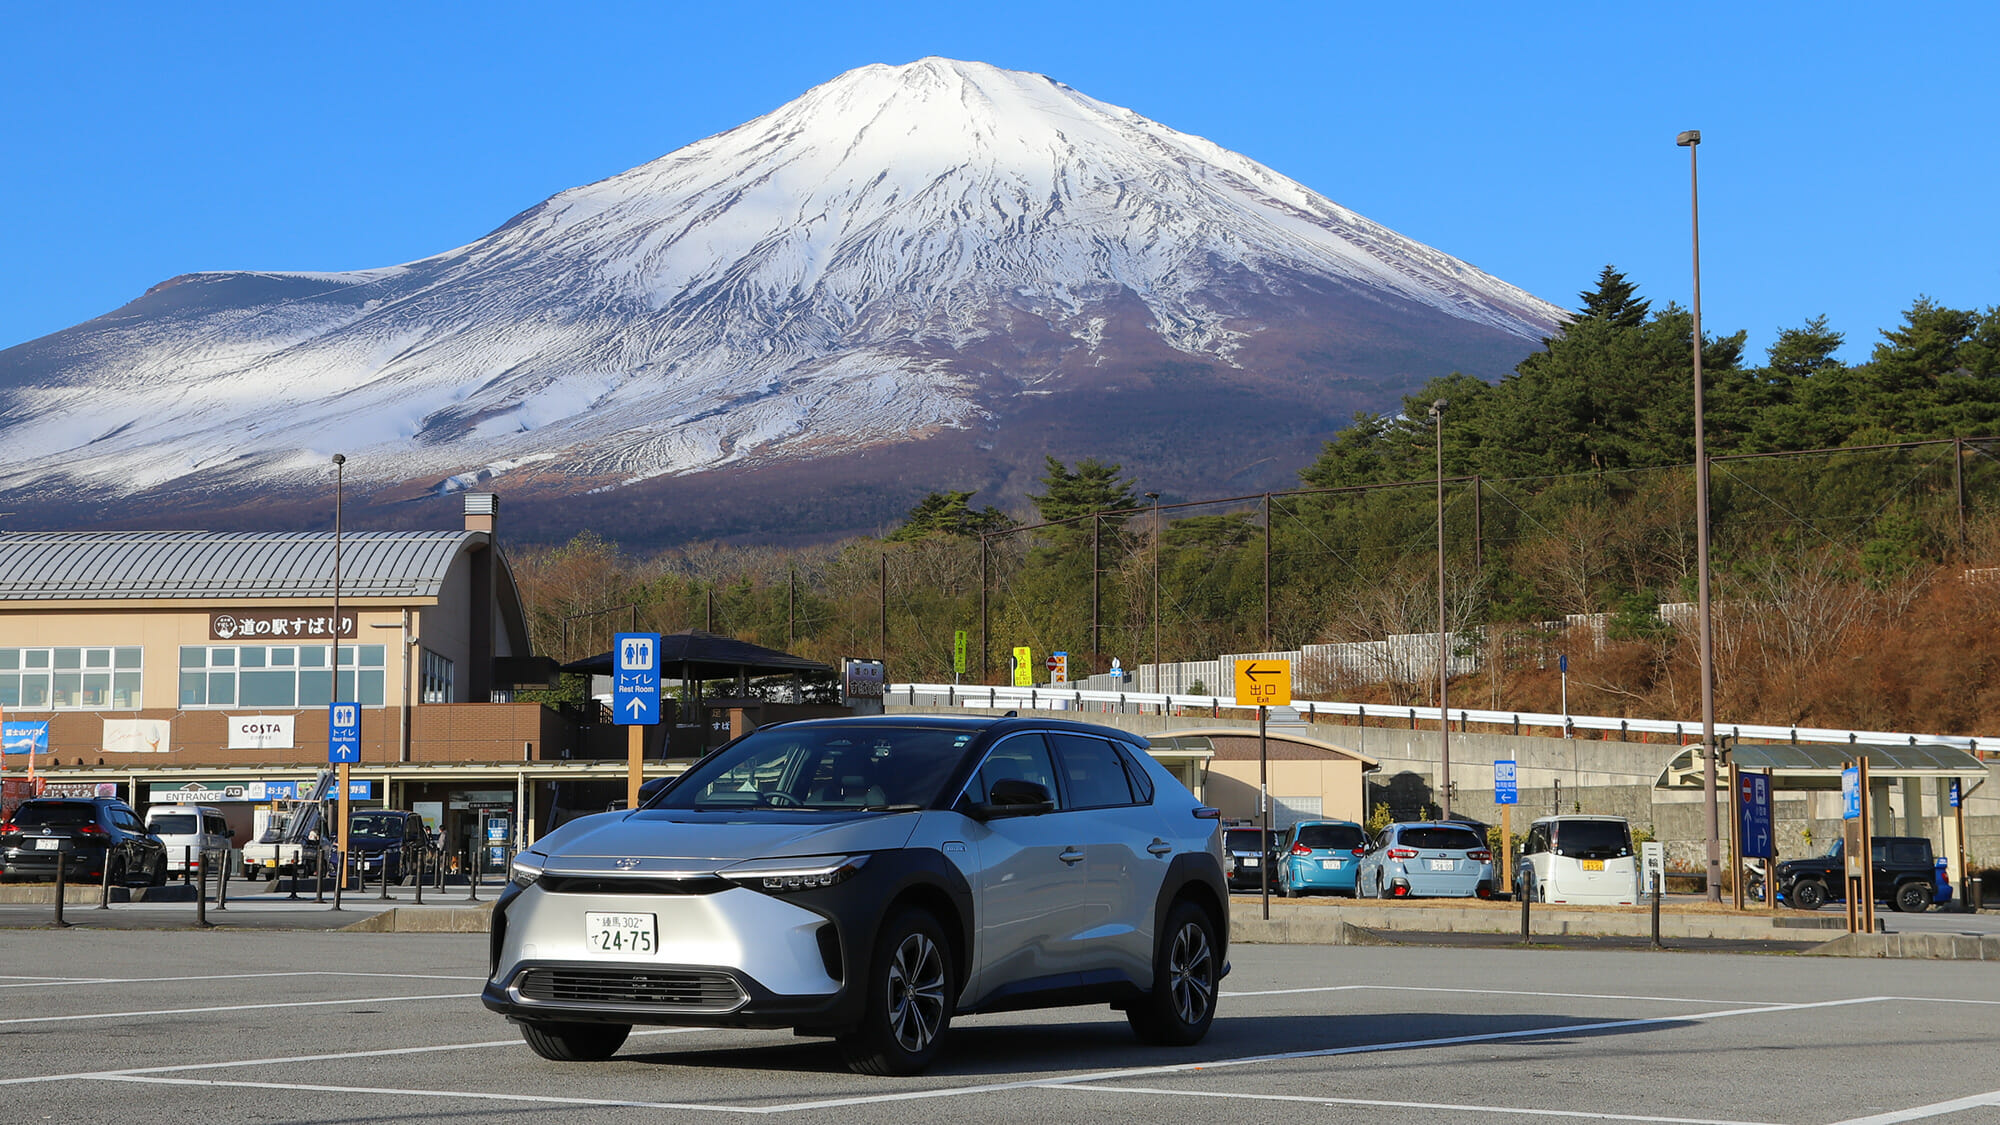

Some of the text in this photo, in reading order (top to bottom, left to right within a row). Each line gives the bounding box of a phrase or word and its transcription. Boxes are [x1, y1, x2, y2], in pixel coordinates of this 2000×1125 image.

[239, 617, 352, 635] 道の駅すばしり
[620, 673, 653, 684] トイレ
[618, 685, 655, 693] Rest Room
[1250, 684, 1276, 695] 出口
[241, 724, 281, 734] COSTA
[166, 793, 220, 801] ENTRANCE
[227, 788, 241, 796] 入口
[623, 917, 639, 928] 302
[602, 930, 650, 951] 24-75
